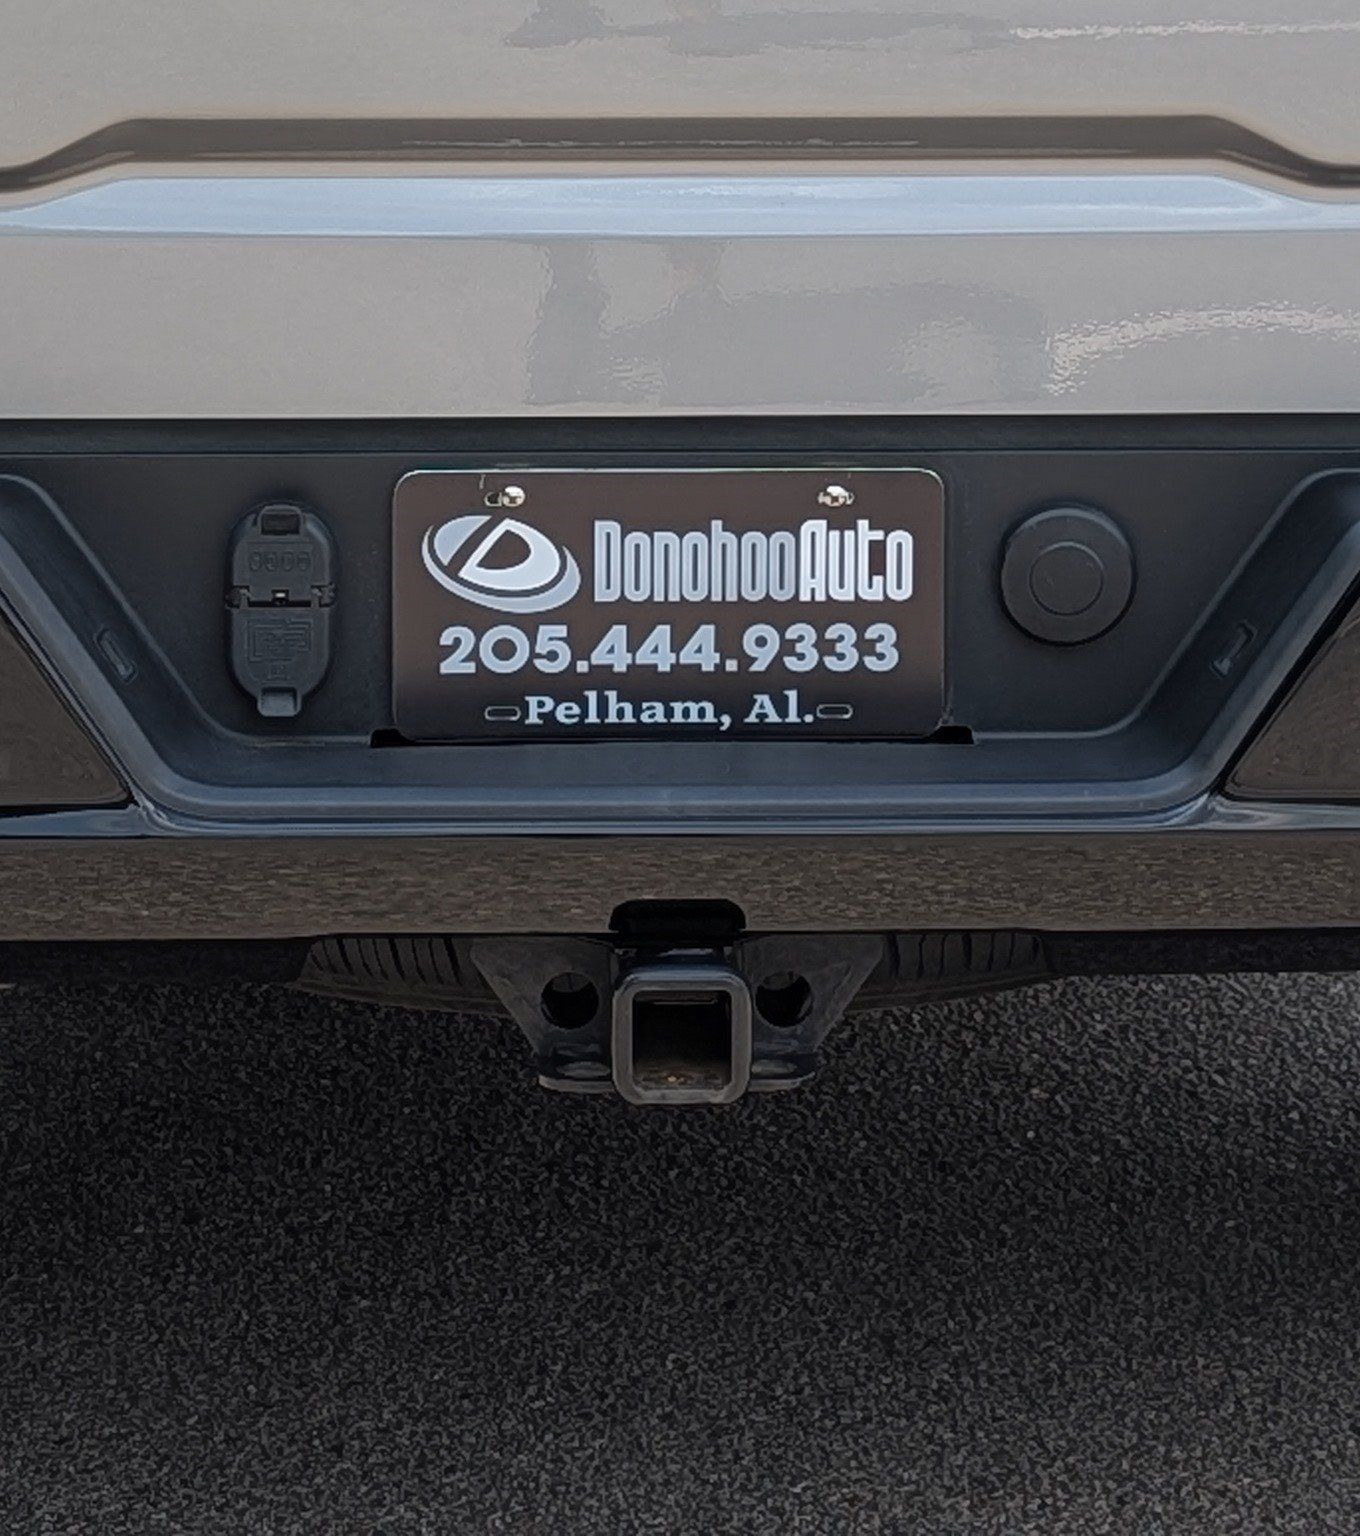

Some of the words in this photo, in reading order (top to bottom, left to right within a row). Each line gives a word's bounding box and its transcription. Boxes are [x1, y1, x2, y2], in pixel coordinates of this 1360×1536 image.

[594, 518, 915, 603] DonohooAuto
[439, 624, 900, 673] 205.444.9333
[524, 689, 731, 730] Pelham,
[743, 689, 814, 725] Al.
